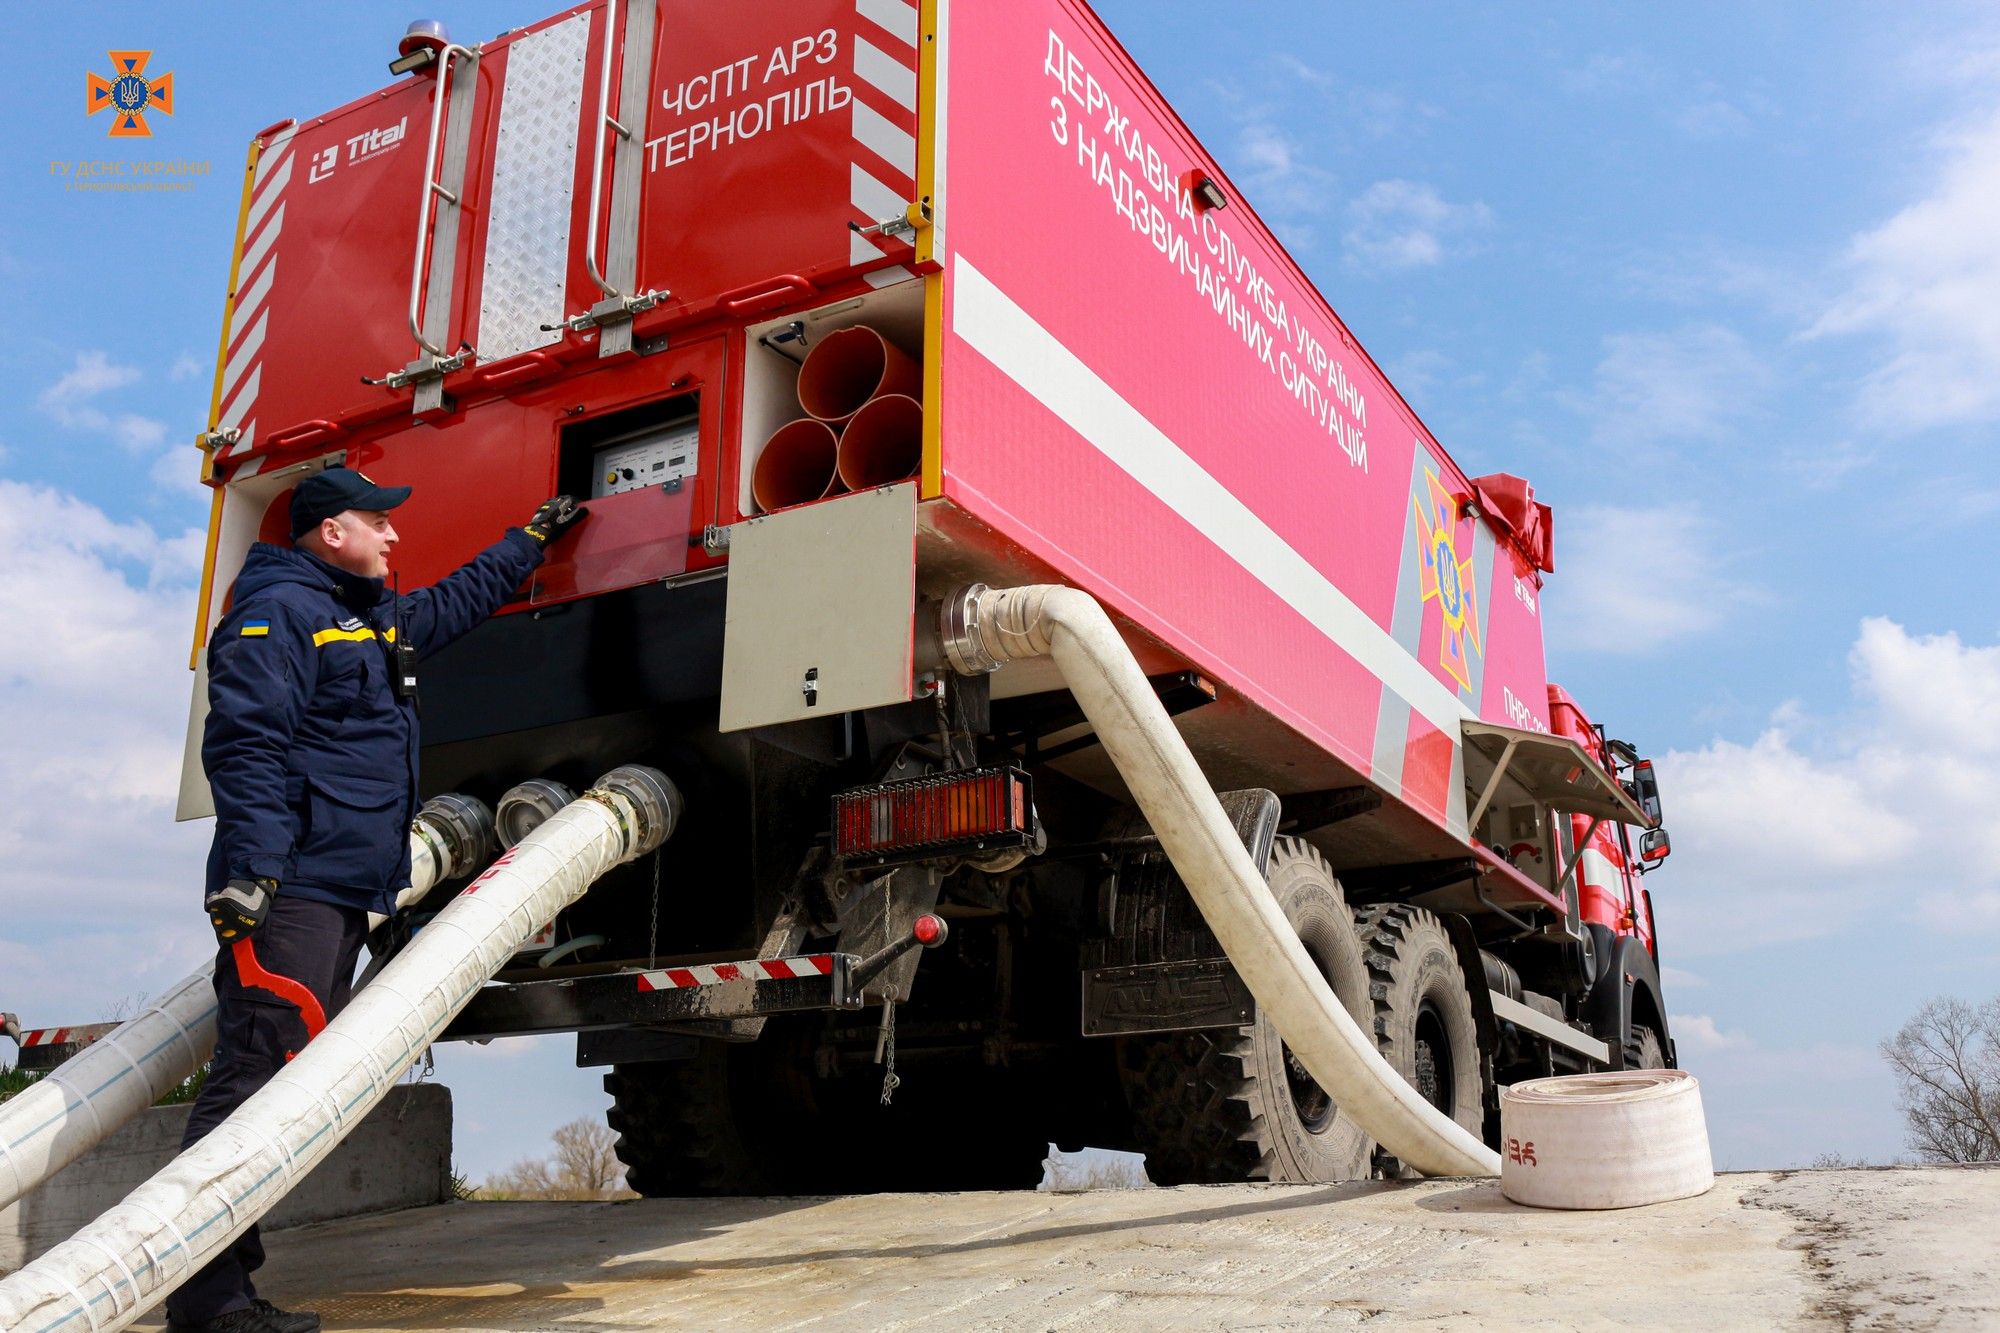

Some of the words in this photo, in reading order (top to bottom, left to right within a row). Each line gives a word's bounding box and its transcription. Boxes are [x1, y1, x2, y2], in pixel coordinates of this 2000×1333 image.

[662, 55, 758, 116] ЧСПТ
[763, 28, 837, 84] АРЗ
[346, 116, 408, 160] Tital
[645, 76, 851, 172] ТЕРНОПІЛЬ
[1045, 29, 1198, 235] ДЕРЖАВНА
[1202, 213, 1291, 343] СЛУЖБА
[1293, 316, 1367, 428] УКРАЇНИ
[1050, 96, 1068, 146] З
[1078, 122, 1276, 374] НАДЗВИЧАЙНИХ
[1279, 351, 1369, 474] СИТУАЦІЙ
